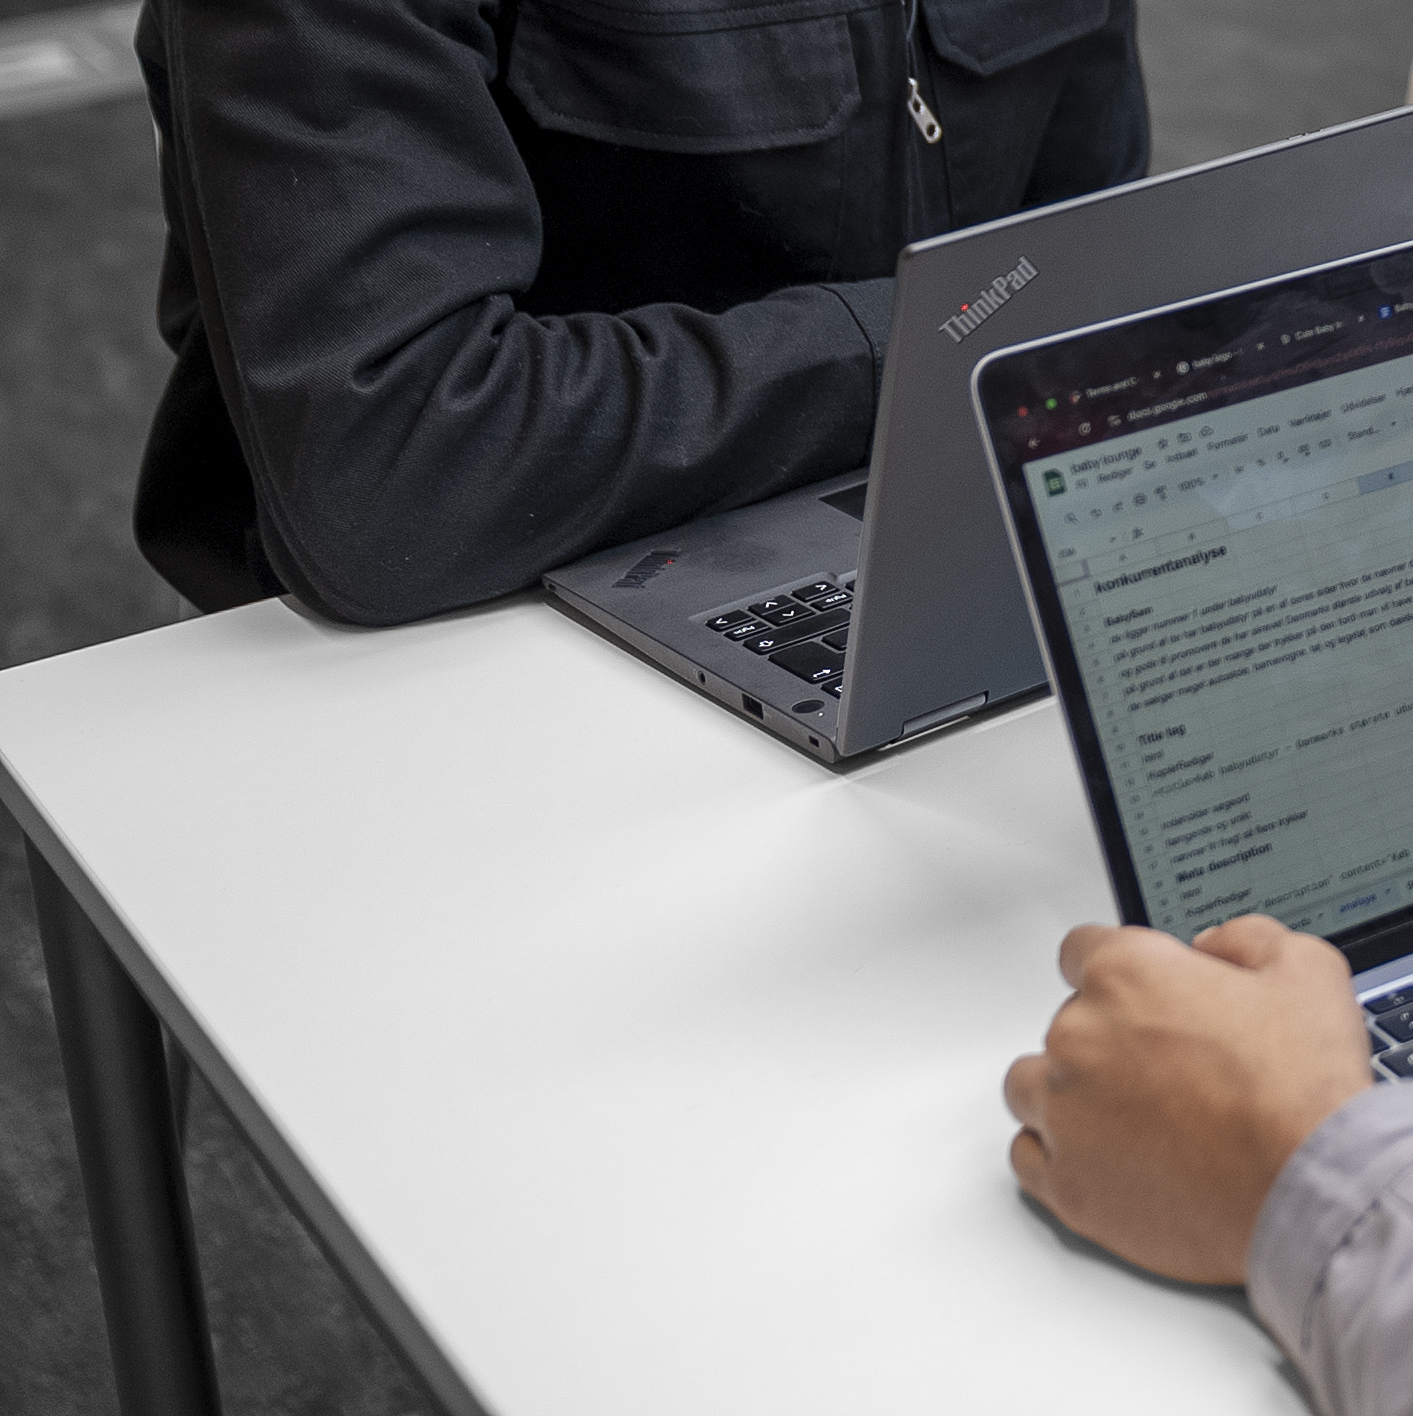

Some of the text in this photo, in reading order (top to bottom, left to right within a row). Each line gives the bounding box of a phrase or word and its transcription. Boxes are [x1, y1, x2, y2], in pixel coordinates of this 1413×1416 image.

[938, 254, 1040, 343] ThinkPad
[1125, 389, 1208, 421] docs.google.com
[1070, 445, 1143, 476] baby lounge
